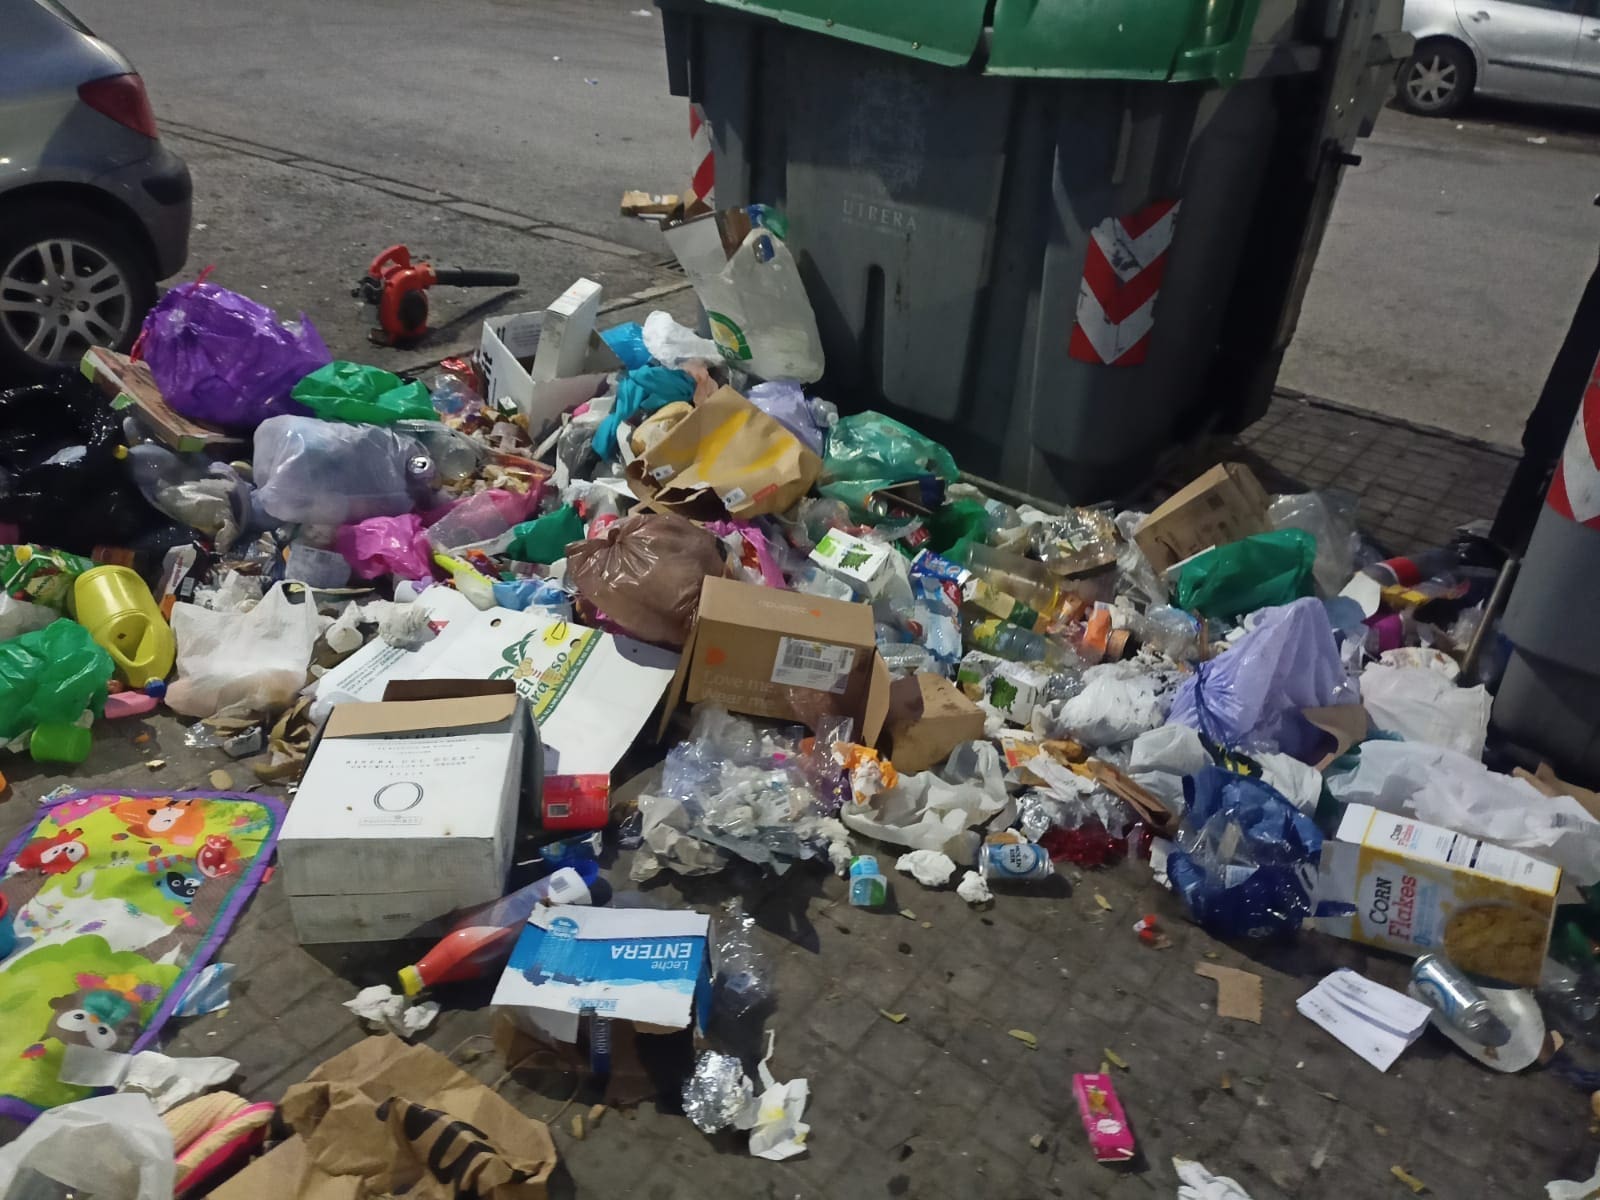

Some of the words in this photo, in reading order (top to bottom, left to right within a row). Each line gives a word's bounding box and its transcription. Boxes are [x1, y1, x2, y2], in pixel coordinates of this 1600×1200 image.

[841, 199, 917, 231] UTRERA
[1369, 876, 1392, 925] CORN
[1388, 875, 1417, 941] Flakes
[611, 942, 693, 960] ENTERA
[650, 960, 689, 971] Leche
